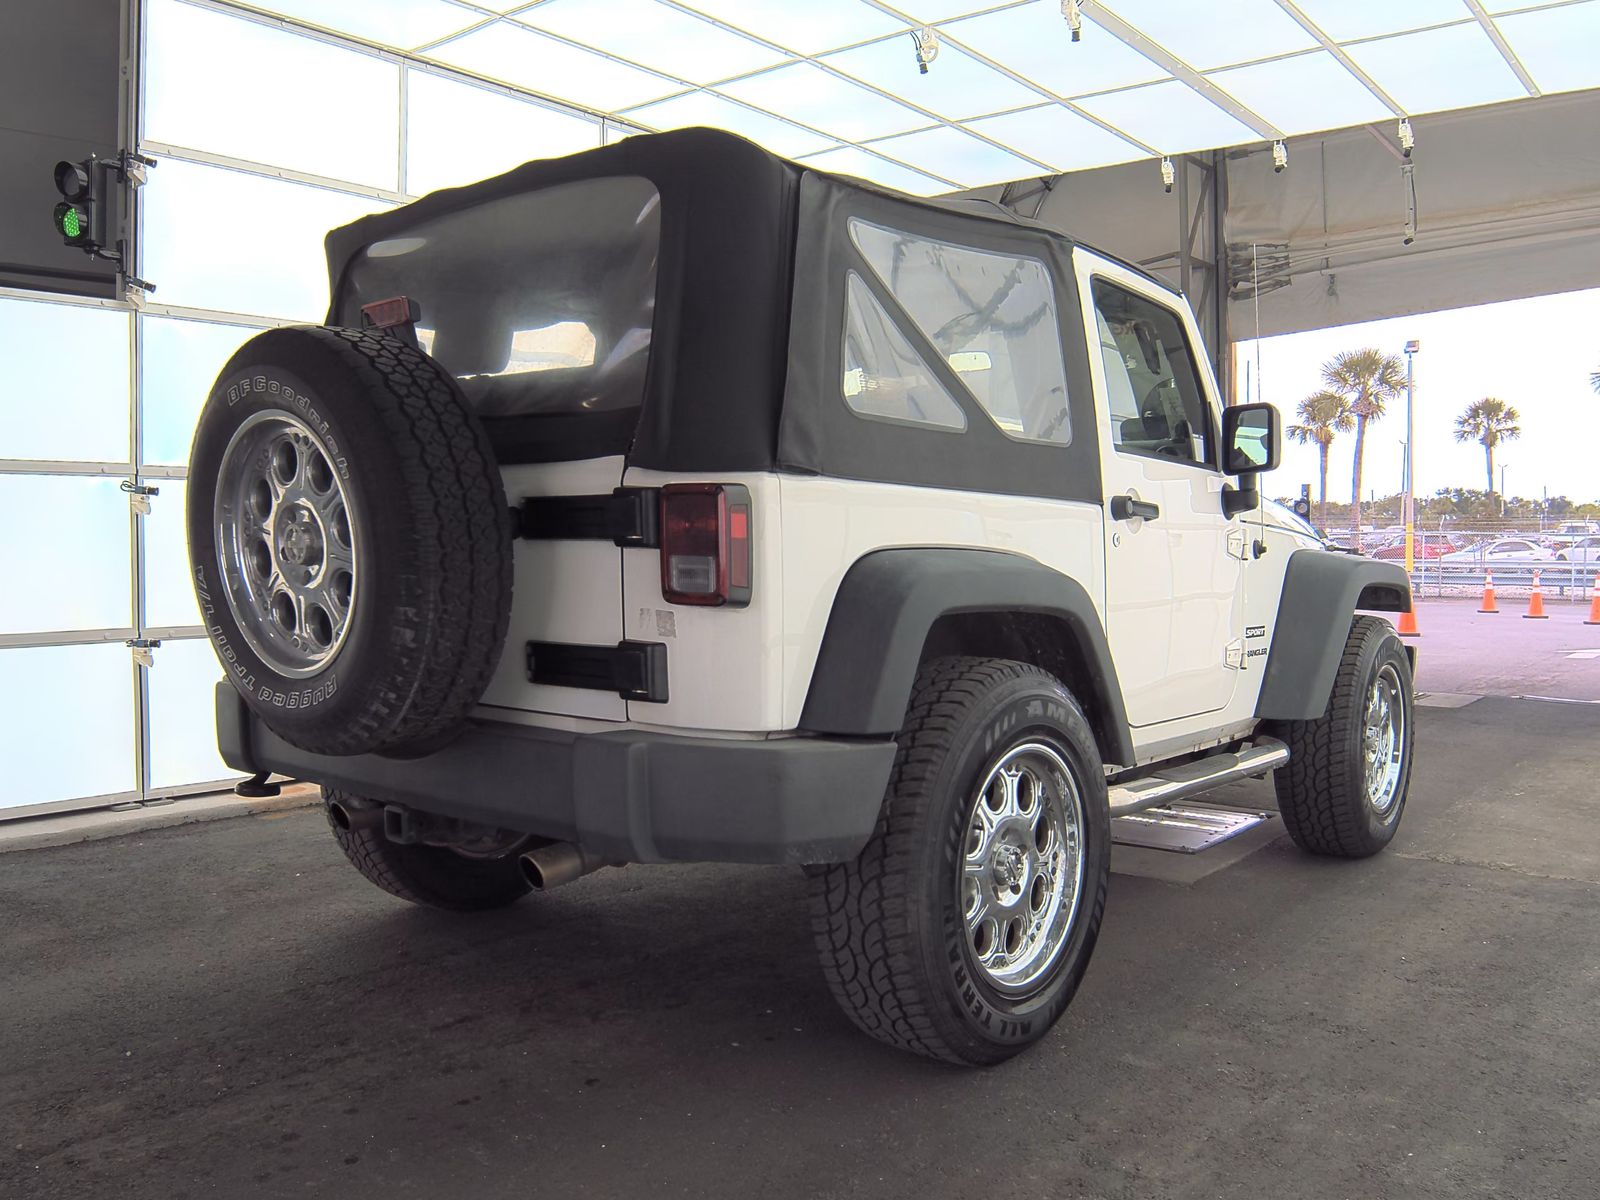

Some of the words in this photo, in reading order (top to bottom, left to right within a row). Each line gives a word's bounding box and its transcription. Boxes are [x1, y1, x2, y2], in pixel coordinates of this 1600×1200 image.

[227, 376, 350, 480] BFGoodrich
[1246, 627, 1265, 637] SPORT
[212, 625, 256, 691] Trail
[258, 675, 337, 709] Rugged
[1000, 1019, 1031, 1037] ALL
